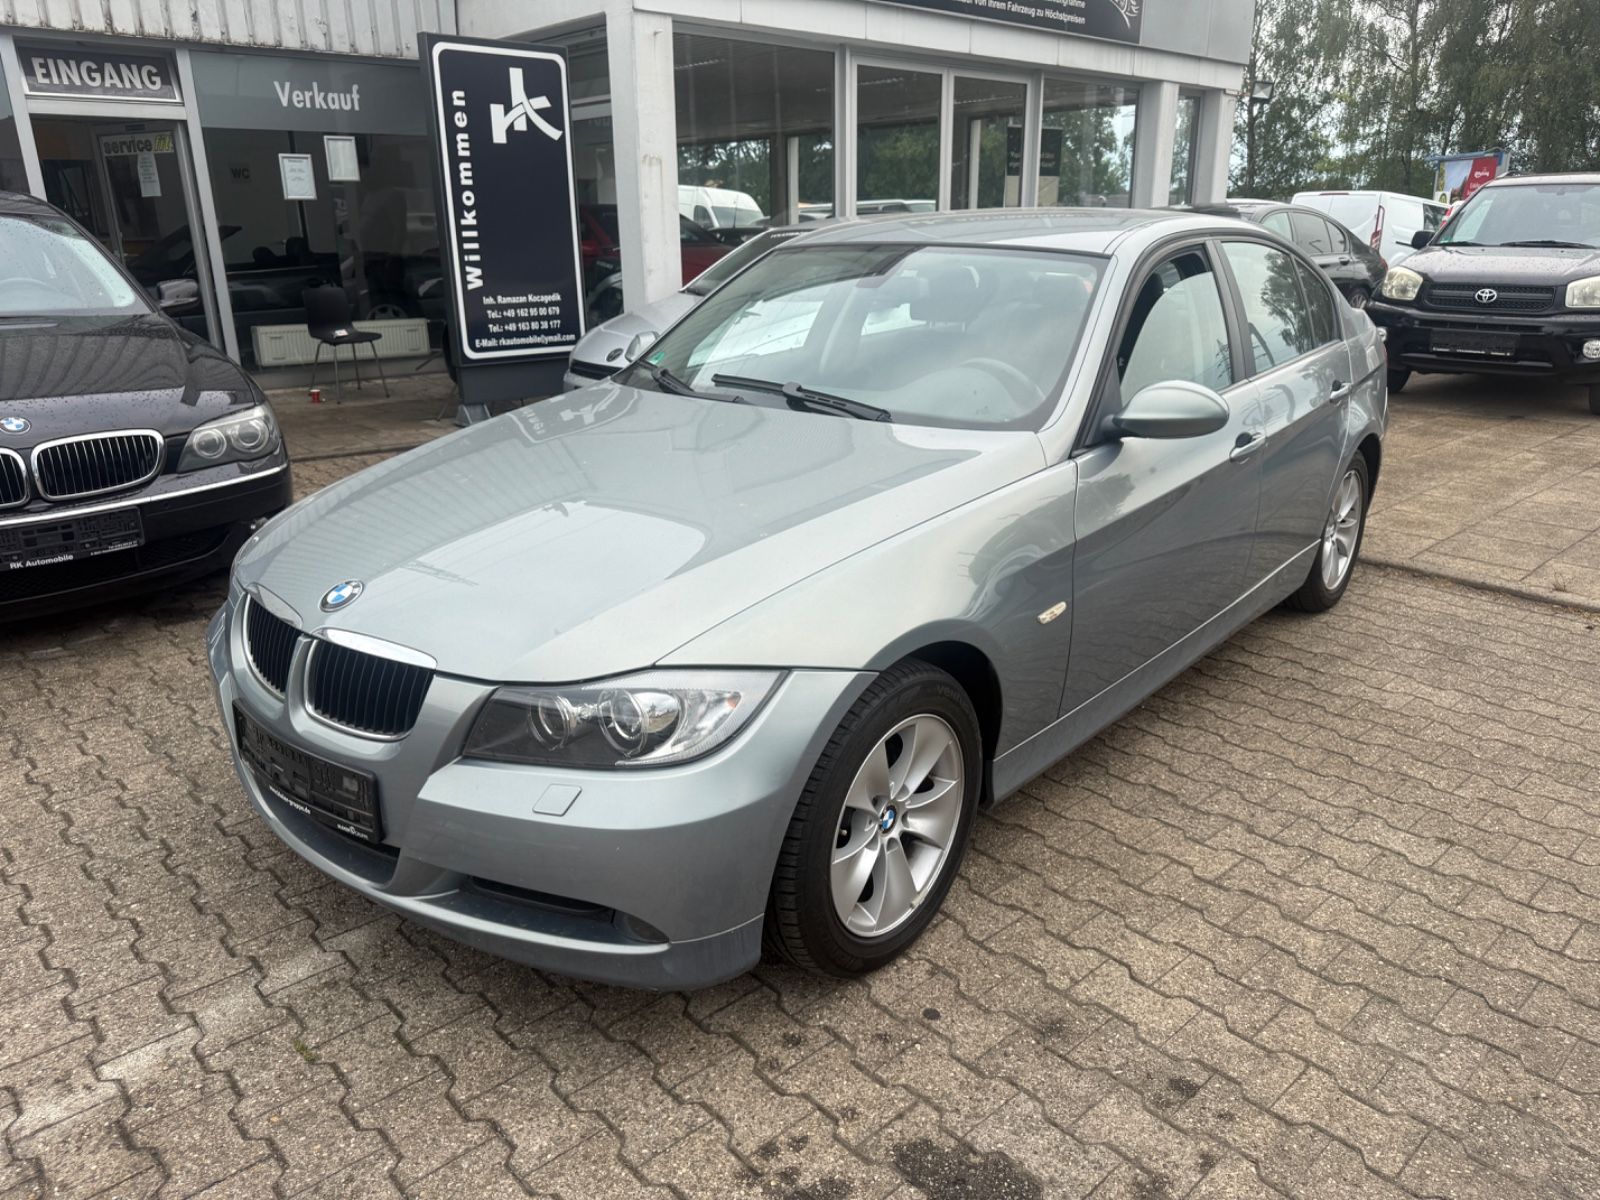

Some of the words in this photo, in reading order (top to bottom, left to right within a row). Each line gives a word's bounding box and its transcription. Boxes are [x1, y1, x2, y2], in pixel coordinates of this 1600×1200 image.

[1007, 2, 1036, 17] Fahrzeug
[1036, 9, 1044, 17] zu
[31, 57, 161, 90] EINGANG
[273, 81, 360, 111] Verkauf
[230, 168, 250, 180] WC
[452, 90, 484, 290] Willkommen
[482, 296, 496, 305] Inh.
[497, 295, 527, 304] Ramazan
[503, 309, 515, 317] +49
[504, 323, 517, 331] +49
[549, 320, 561, 328] 177
[10, 561, 24, 570] RK
[25, 554, 74, 568] Automobile
